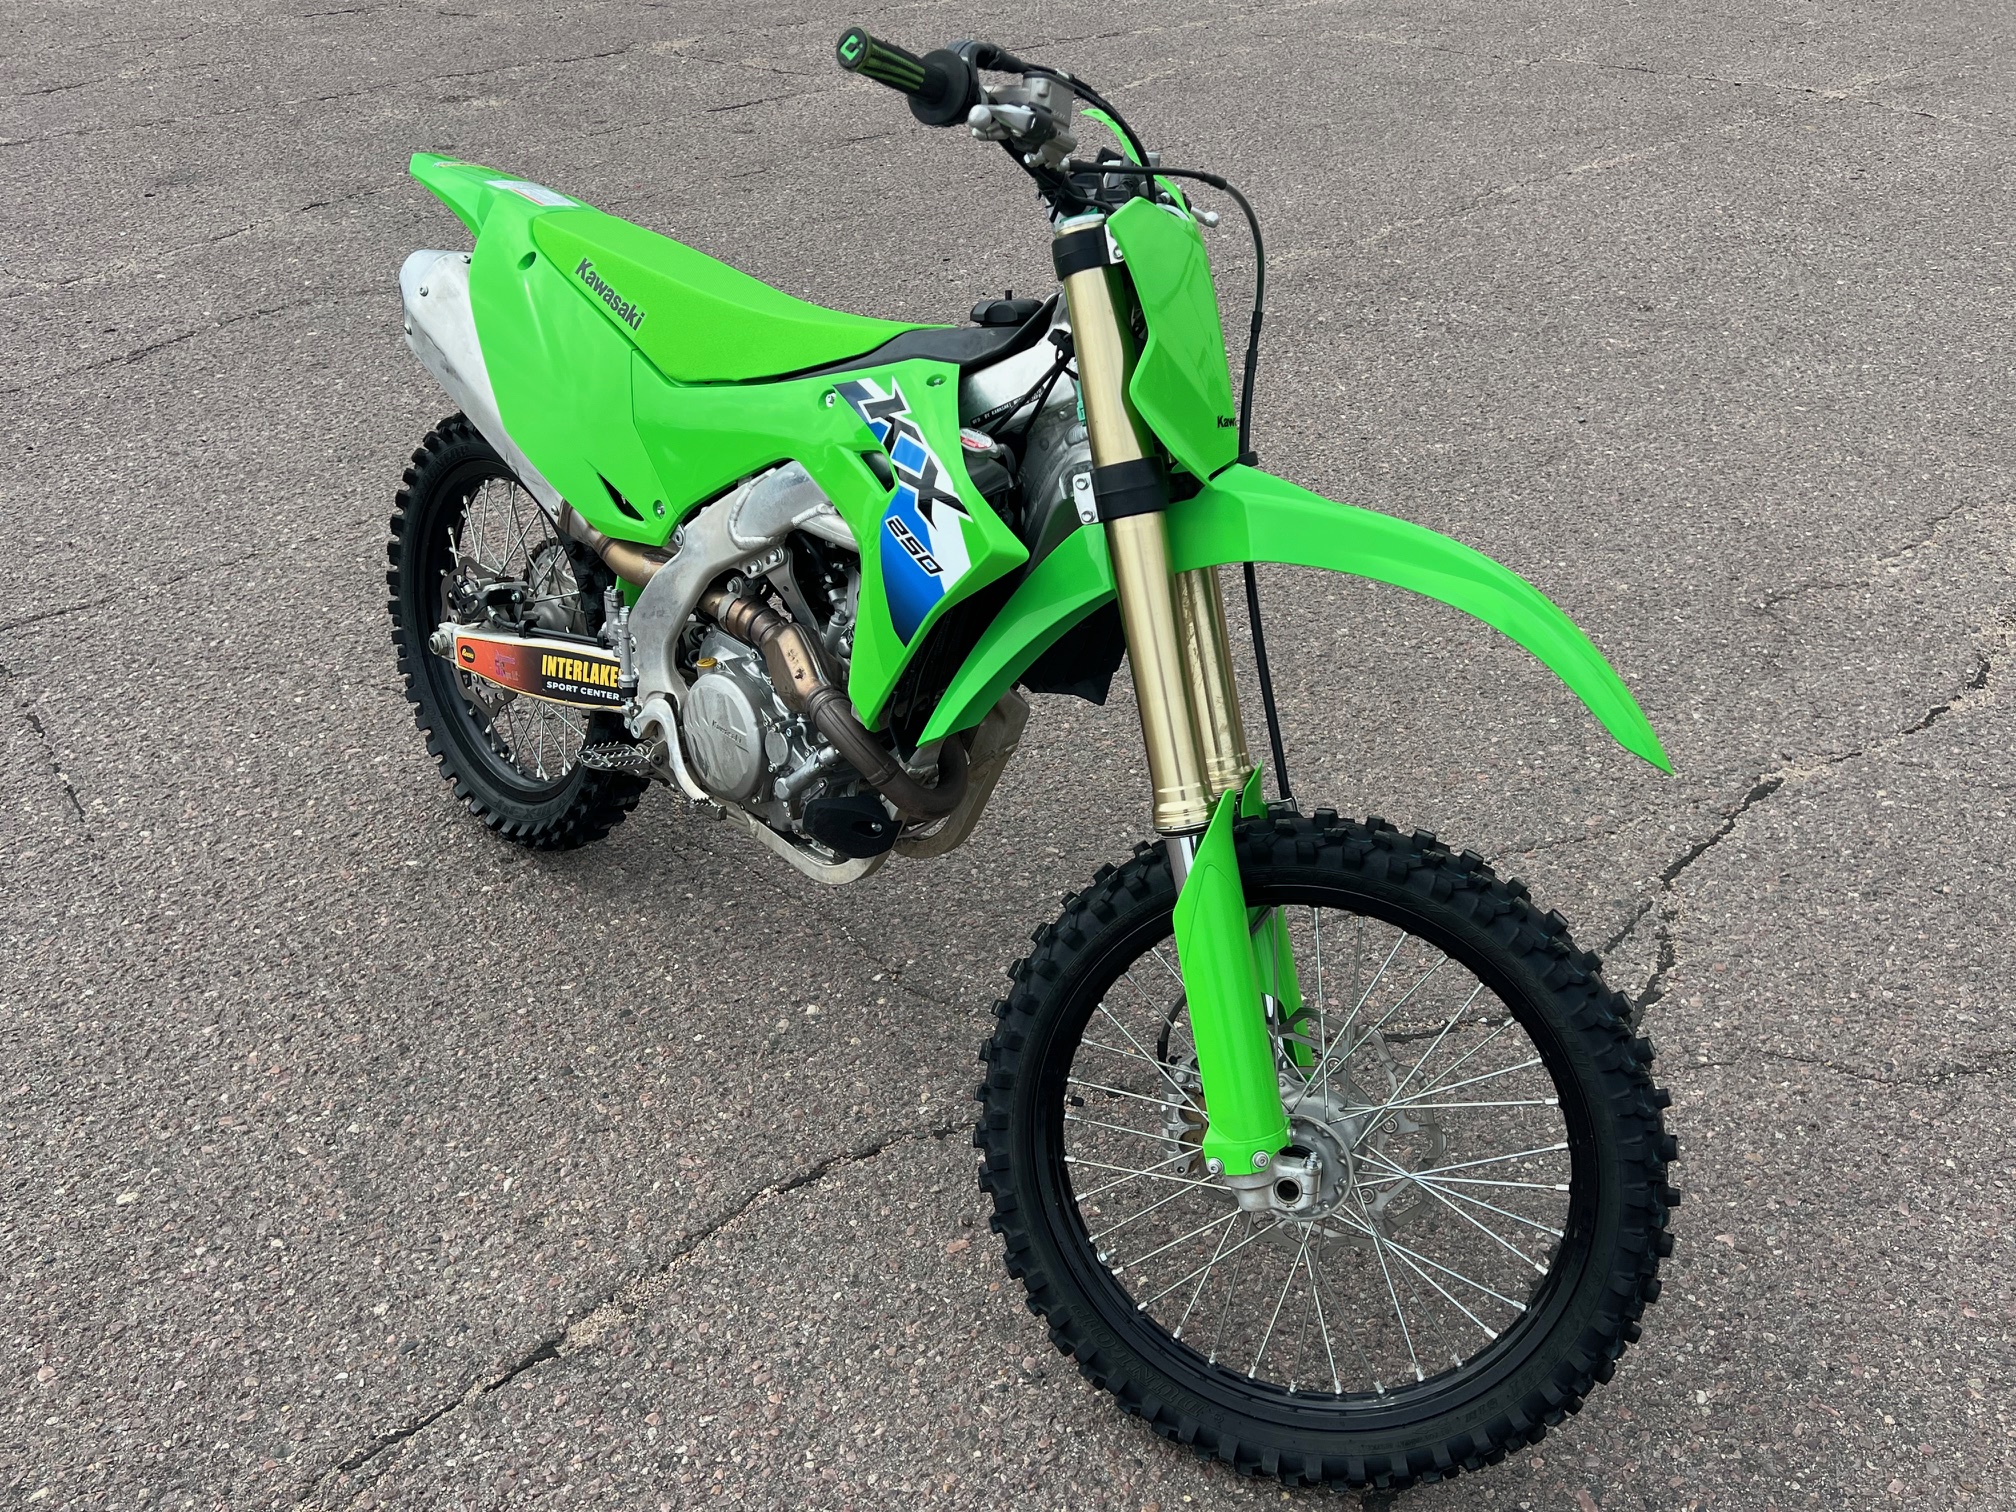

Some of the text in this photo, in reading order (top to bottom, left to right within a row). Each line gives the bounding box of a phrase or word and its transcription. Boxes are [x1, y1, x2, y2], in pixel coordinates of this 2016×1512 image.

[575, 257, 645, 331] Kawasaki
[859, 378, 972, 531] KX
[886, 516, 944, 576] 250
[546, 681, 579, 694] SPORT
[580, 687, 620, 701] CENTER
[1071, 1304, 1209, 1417] DUNLOP
